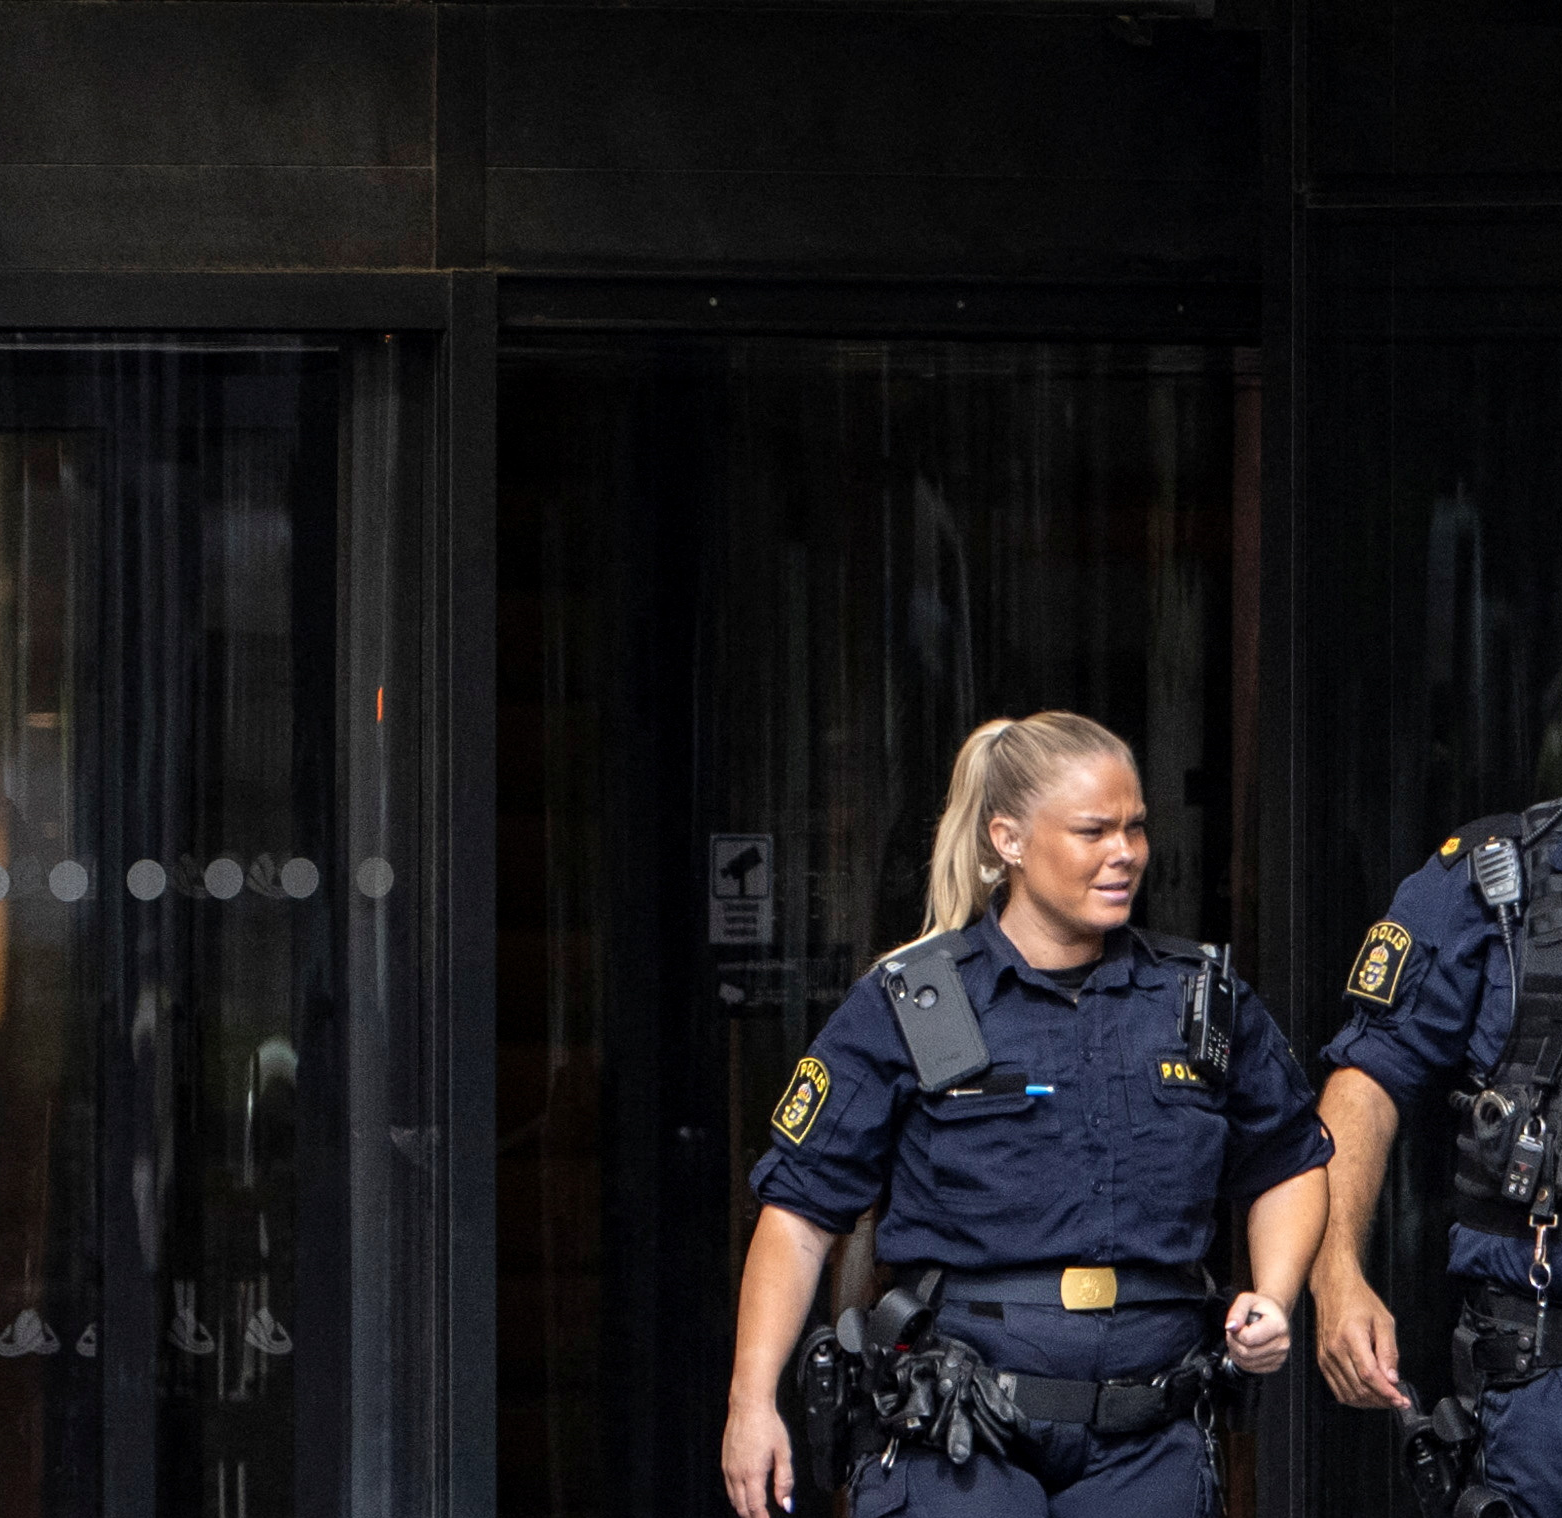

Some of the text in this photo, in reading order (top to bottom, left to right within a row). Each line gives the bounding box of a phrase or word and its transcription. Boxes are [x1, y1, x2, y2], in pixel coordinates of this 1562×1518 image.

[1369, 924, 1408, 952] POLIS
[799, 1061, 827, 1094] POLIS
[1160, 1062, 1198, 1081] POL
